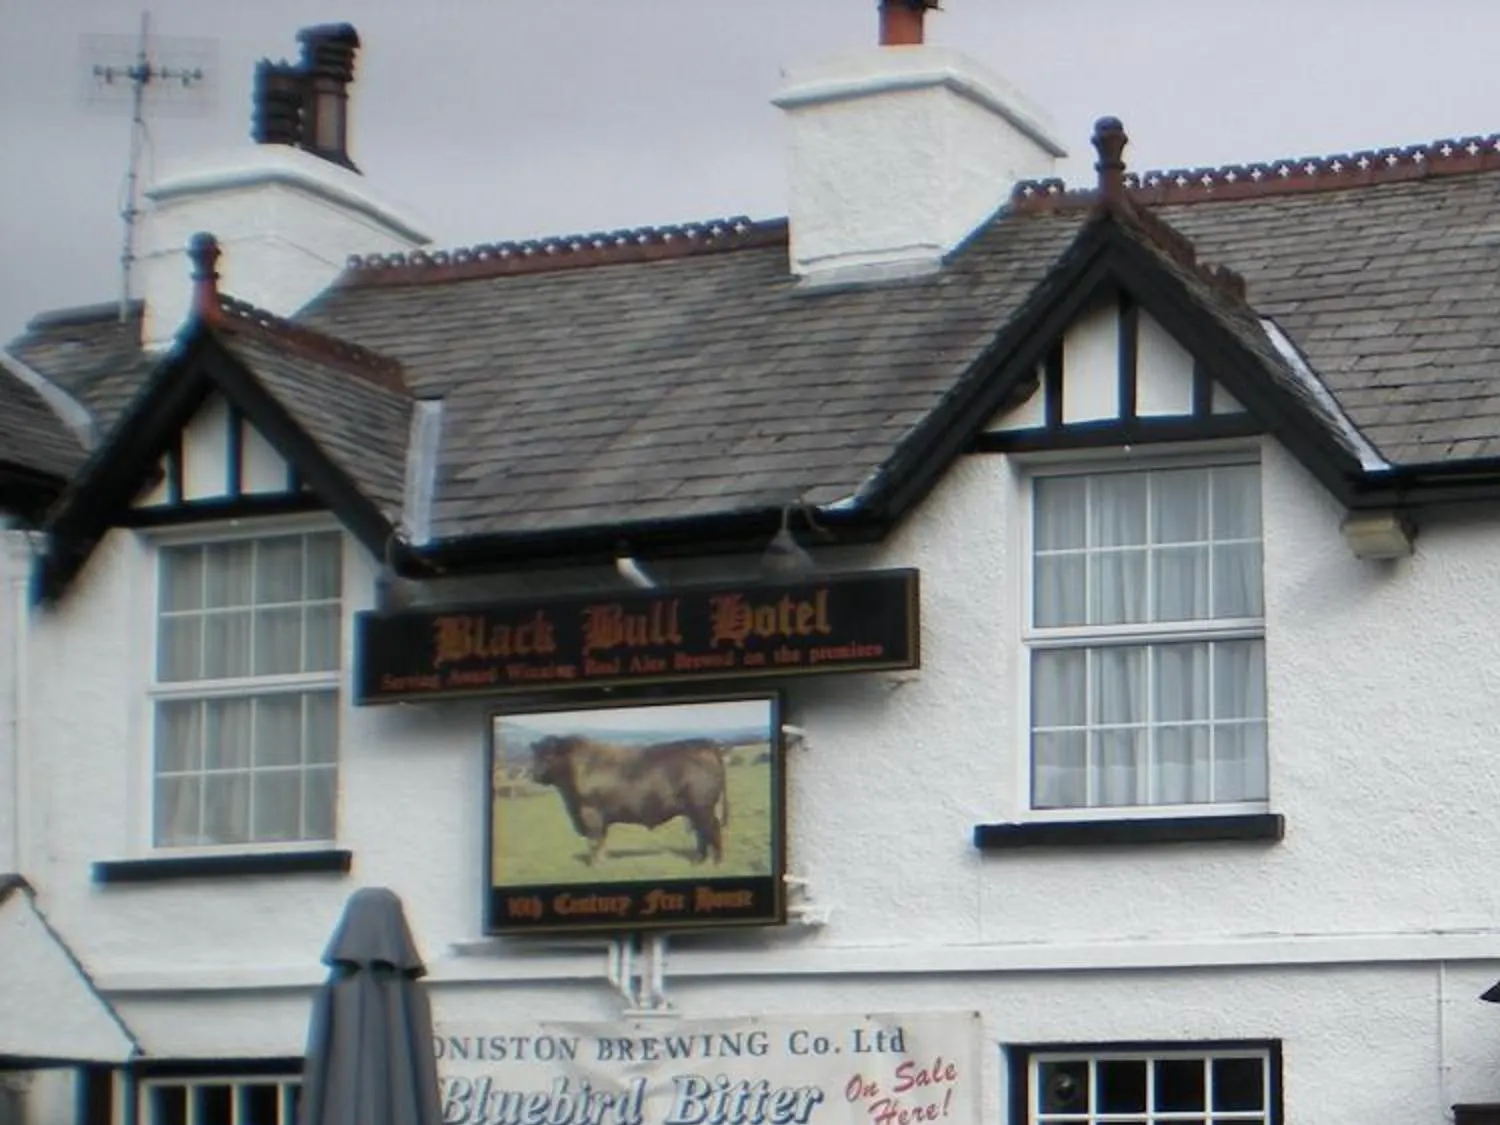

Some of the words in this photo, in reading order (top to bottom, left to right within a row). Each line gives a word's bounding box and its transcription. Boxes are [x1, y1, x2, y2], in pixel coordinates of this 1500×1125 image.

[432, 611, 556, 669] Black
[581, 599, 682, 657] Bull
[710, 589, 832, 649] Hotel
[506, 662, 577, 682] Winning
[584, 656, 621, 675] Real
[629, 655, 667, 673] Ales
[743, 652, 766, 666] on
[773, 645, 802, 664] the
[809, 641, 884, 664] premises
[553, 892, 632, 918] Century
[640, 888, 686, 915] Free
[694, 886, 753, 913] House
[433, 1035, 579, 1062] ONISTON
[597, 1030, 769, 1061] BREWING
[788, 1029, 841, 1056] Co.
[852, 1025, 906, 1054] Ltd
[844, 1073, 880, 1104] On
[893, 1057, 958, 1094] Sale
